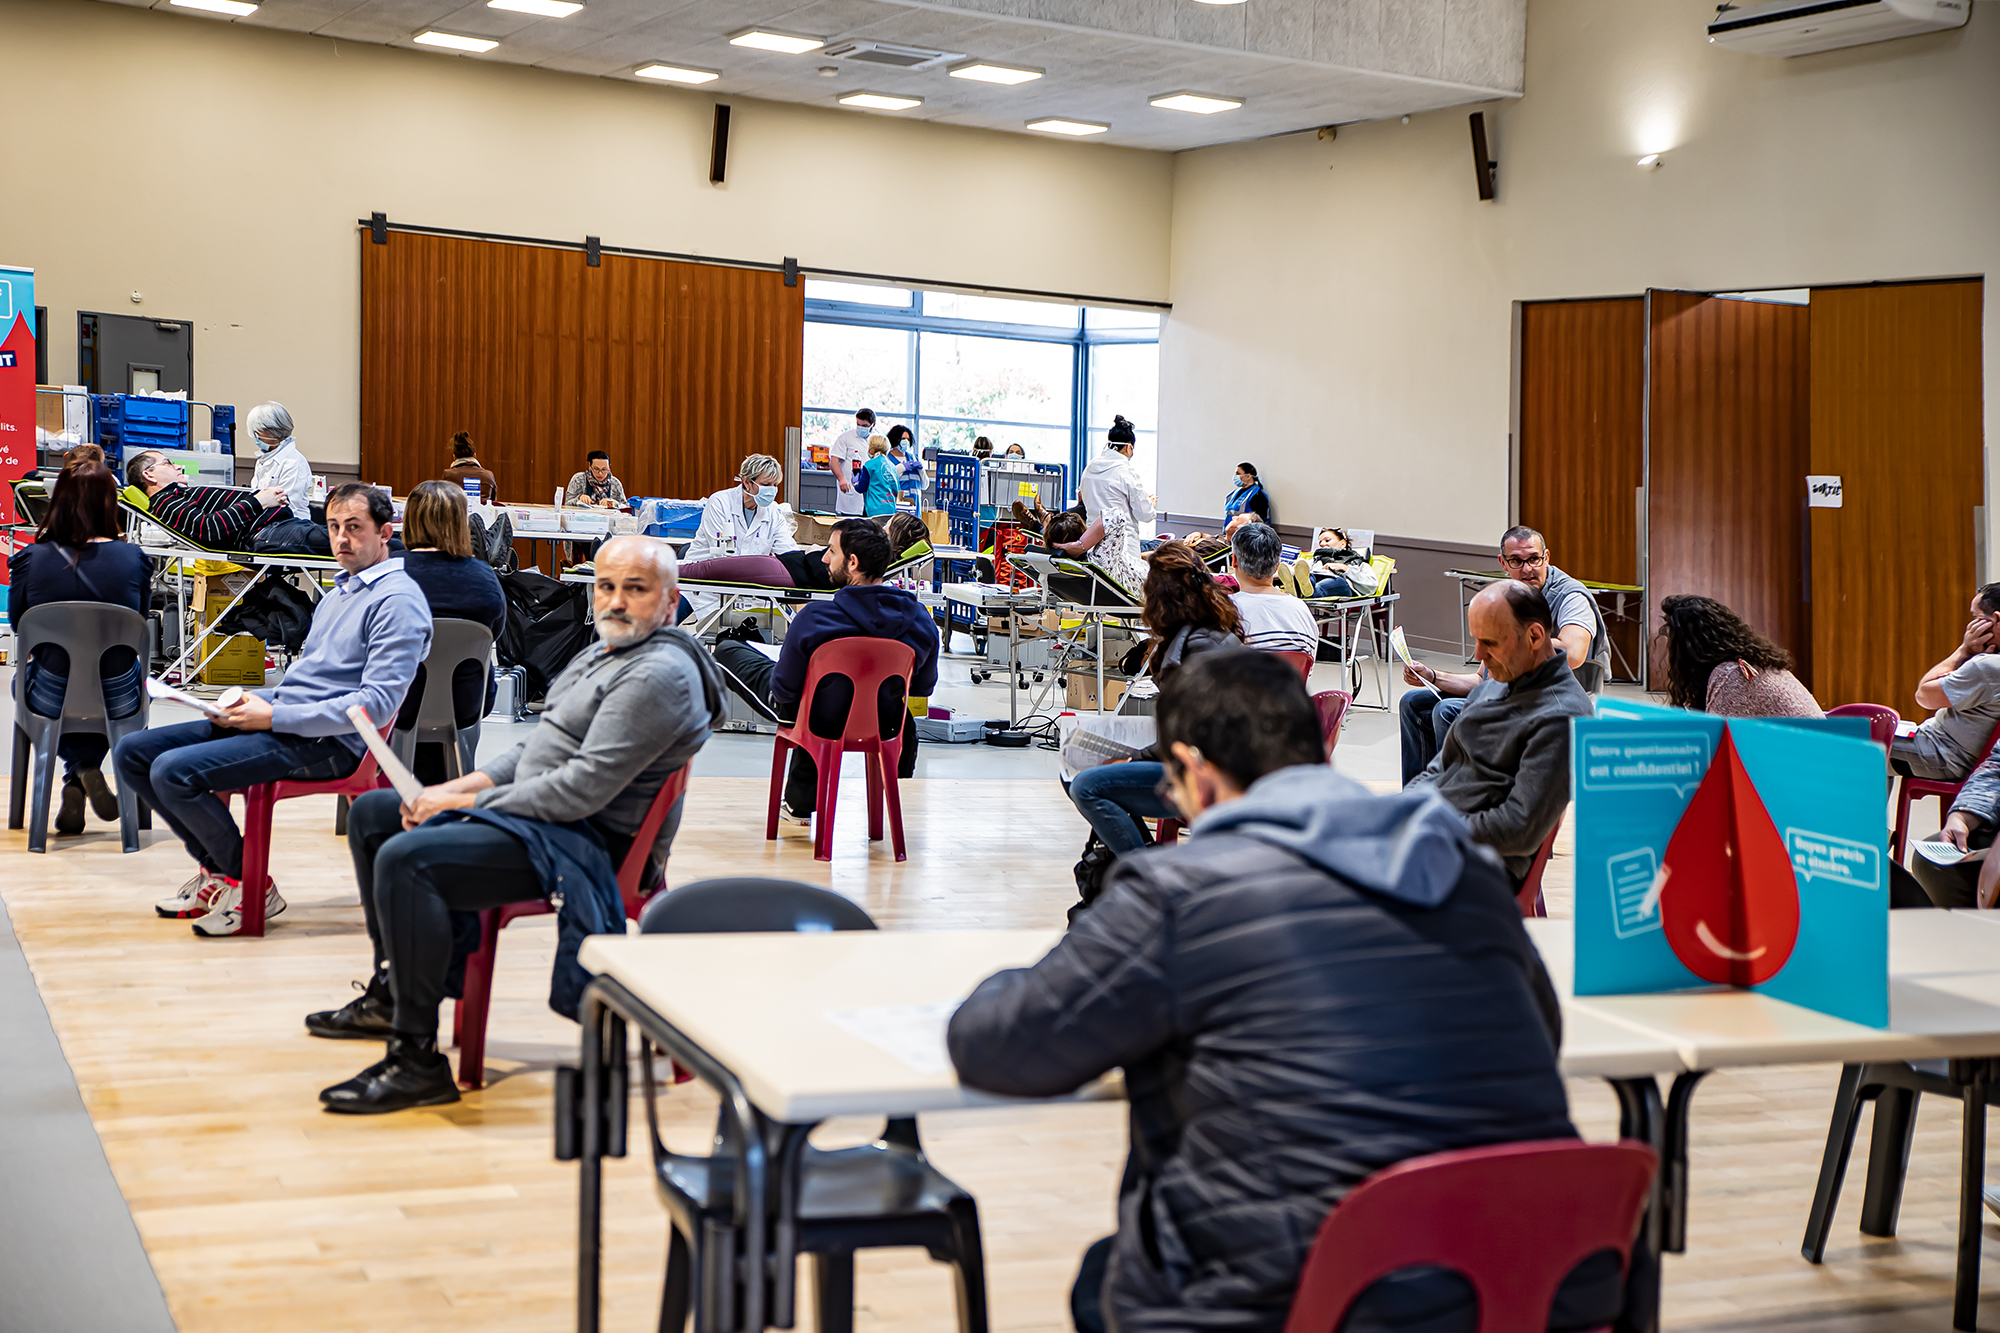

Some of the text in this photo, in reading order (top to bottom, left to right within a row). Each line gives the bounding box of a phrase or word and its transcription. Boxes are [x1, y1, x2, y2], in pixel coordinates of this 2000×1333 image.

[1, 422, 17, 432] lits.
[5, 457, 19, 466] de
[1624, 743, 1700, 759] questionnaire
[1589, 765, 1609, 777] est
[1613, 761, 1692, 777] confidentiel
